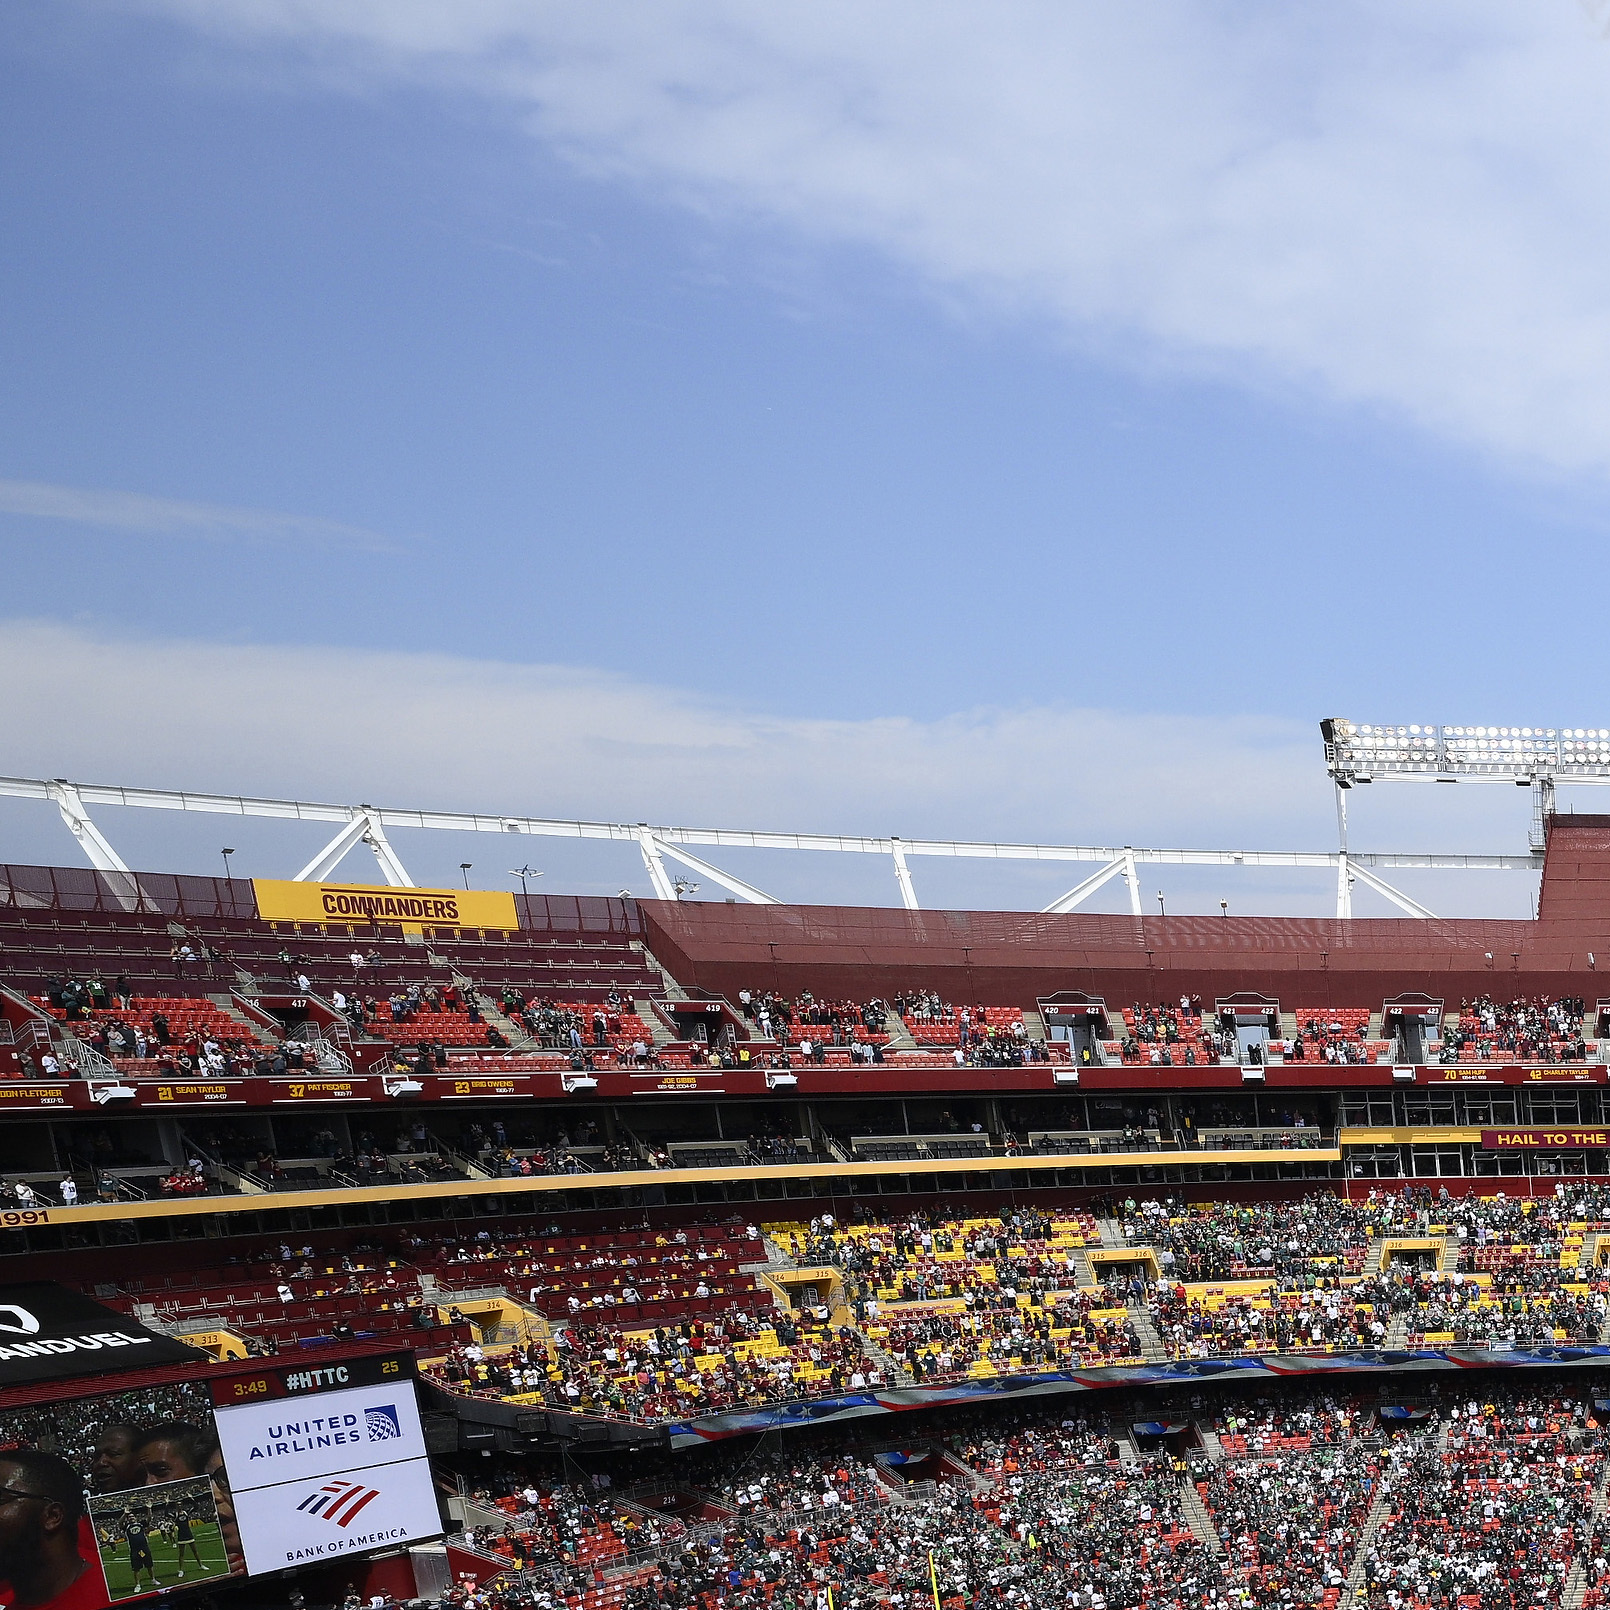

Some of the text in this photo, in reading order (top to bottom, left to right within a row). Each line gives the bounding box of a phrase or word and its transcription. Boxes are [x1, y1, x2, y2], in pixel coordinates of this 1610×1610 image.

[322, 894, 459, 920] COMMANDERS
[291, 1000, 307, 1008] 417
[705, 1004, 721, 1012] 419
[1530, 1069, 1542, 1080] 42
[20, 1088, 62, 1098] FLETCHER
[158, 1086, 174, 1101] 21
[175, 1086, 198, 1094] SEAN
[289, 1084, 305, 1098] 37
[308, 1084, 324, 1092] PAT
[1497, 1132, 1607, 1145] HAIL TO THE
[0, 1332, 152, 1360] ANDUEL
[381, 1361, 399, 1375] 25
[234, 1366, 349, 1397] #HTTC 3:49
[268, 1414, 357, 1439] UNITED
[249, 1429, 361, 1460] AIRLINES
[286, 1527, 408, 1562] BANK OF AMERICA
